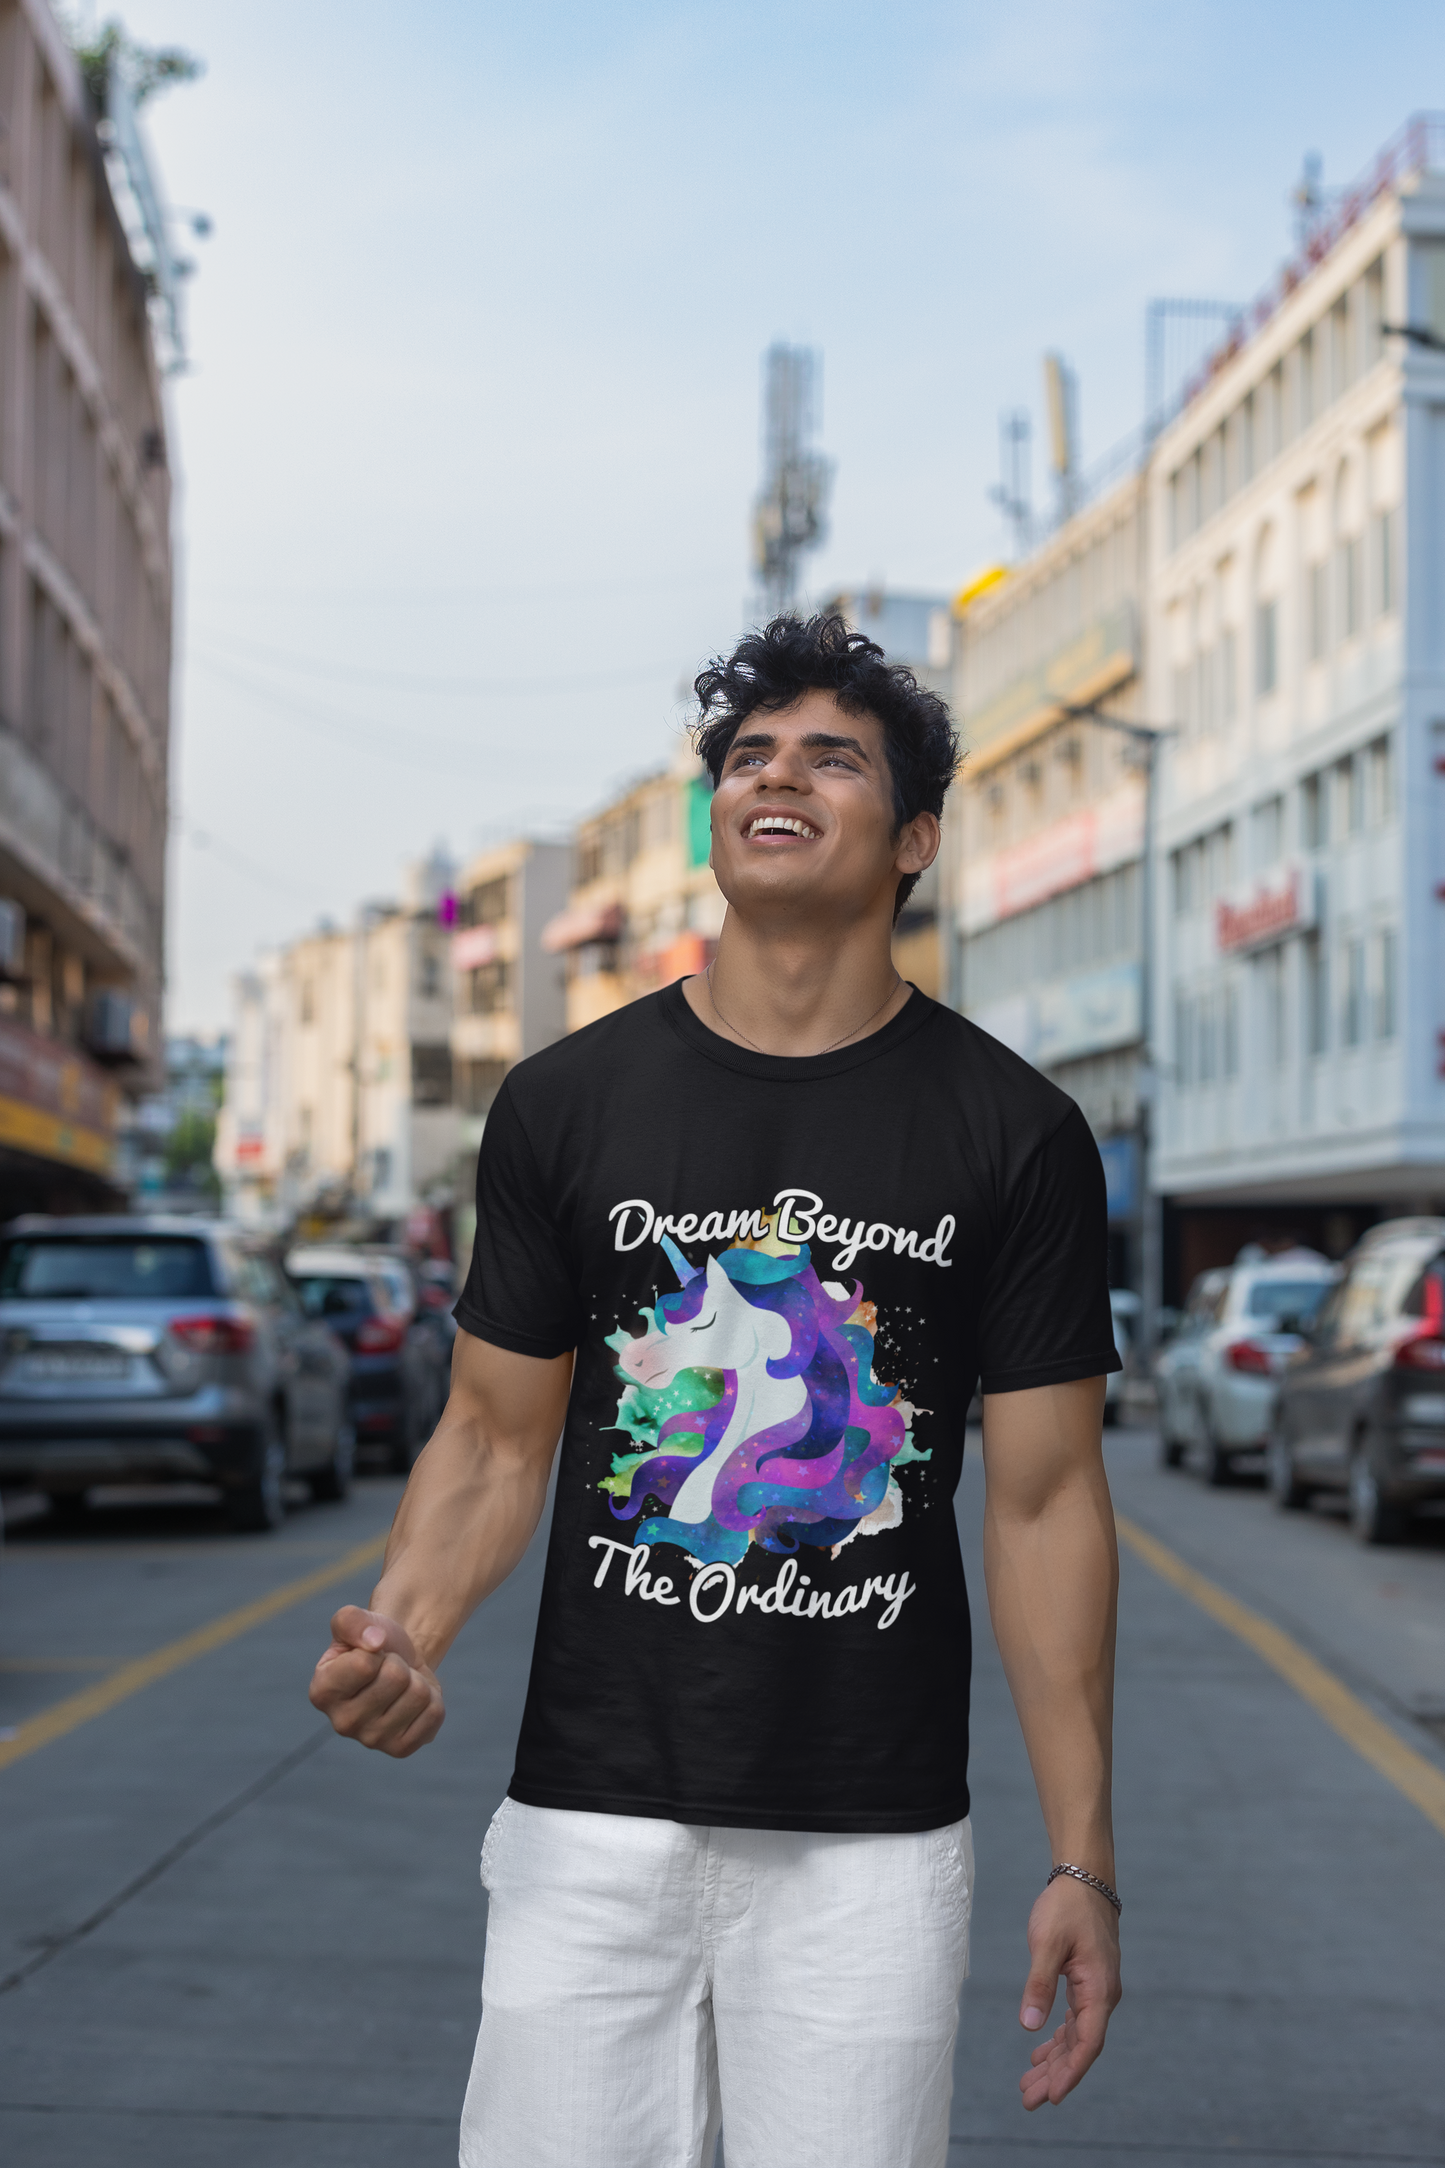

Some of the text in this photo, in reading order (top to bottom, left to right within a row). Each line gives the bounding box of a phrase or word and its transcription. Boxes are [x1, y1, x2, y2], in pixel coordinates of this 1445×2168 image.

[608, 1188, 957, 1272] Dream Beyond
[588, 1535, 916, 1630] The Ordinary
